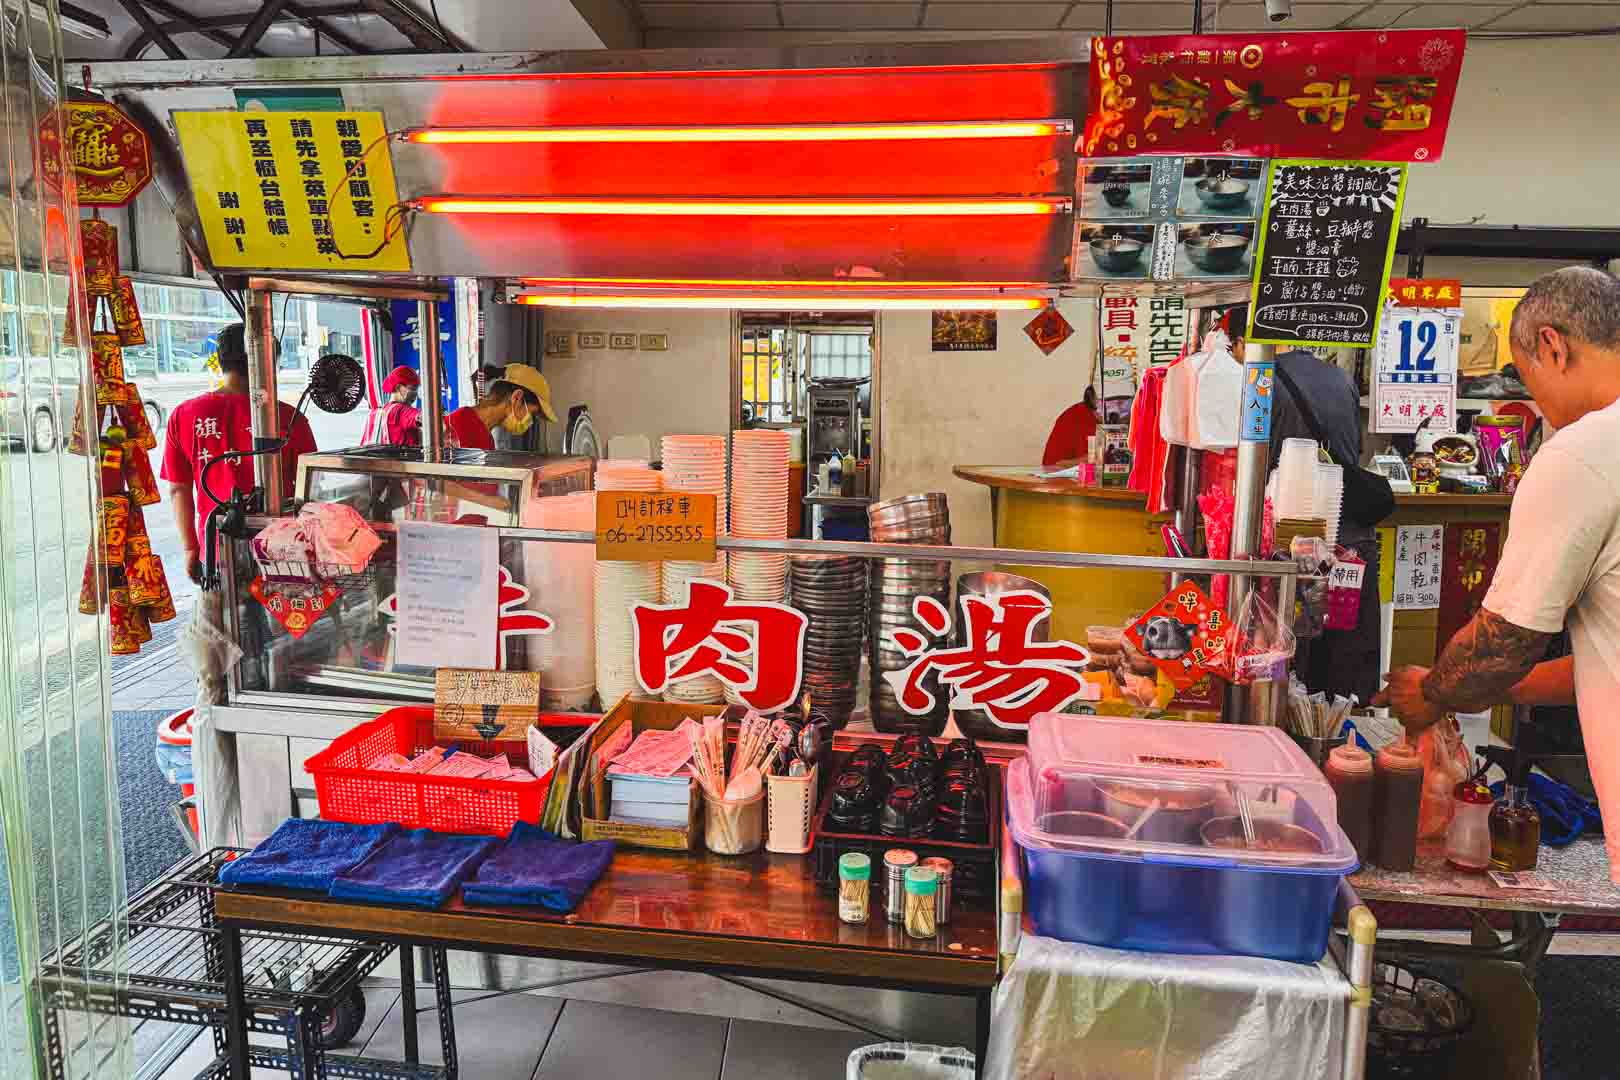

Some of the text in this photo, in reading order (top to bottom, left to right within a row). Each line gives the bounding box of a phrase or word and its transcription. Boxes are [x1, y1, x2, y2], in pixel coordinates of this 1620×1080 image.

[1279, 203, 1312, 216] 牛肉湯
[1395, 320, 1438, 371] 12
[1382, 403, 1447, 418] 大明米廠
[616, 495, 691, 521] 叫計程車
[607, 522, 704, 544] 06-2755555
[1410, 529, 1428, 590] 牛肉乾
[1328, 565, 1359, 585] 帶用
